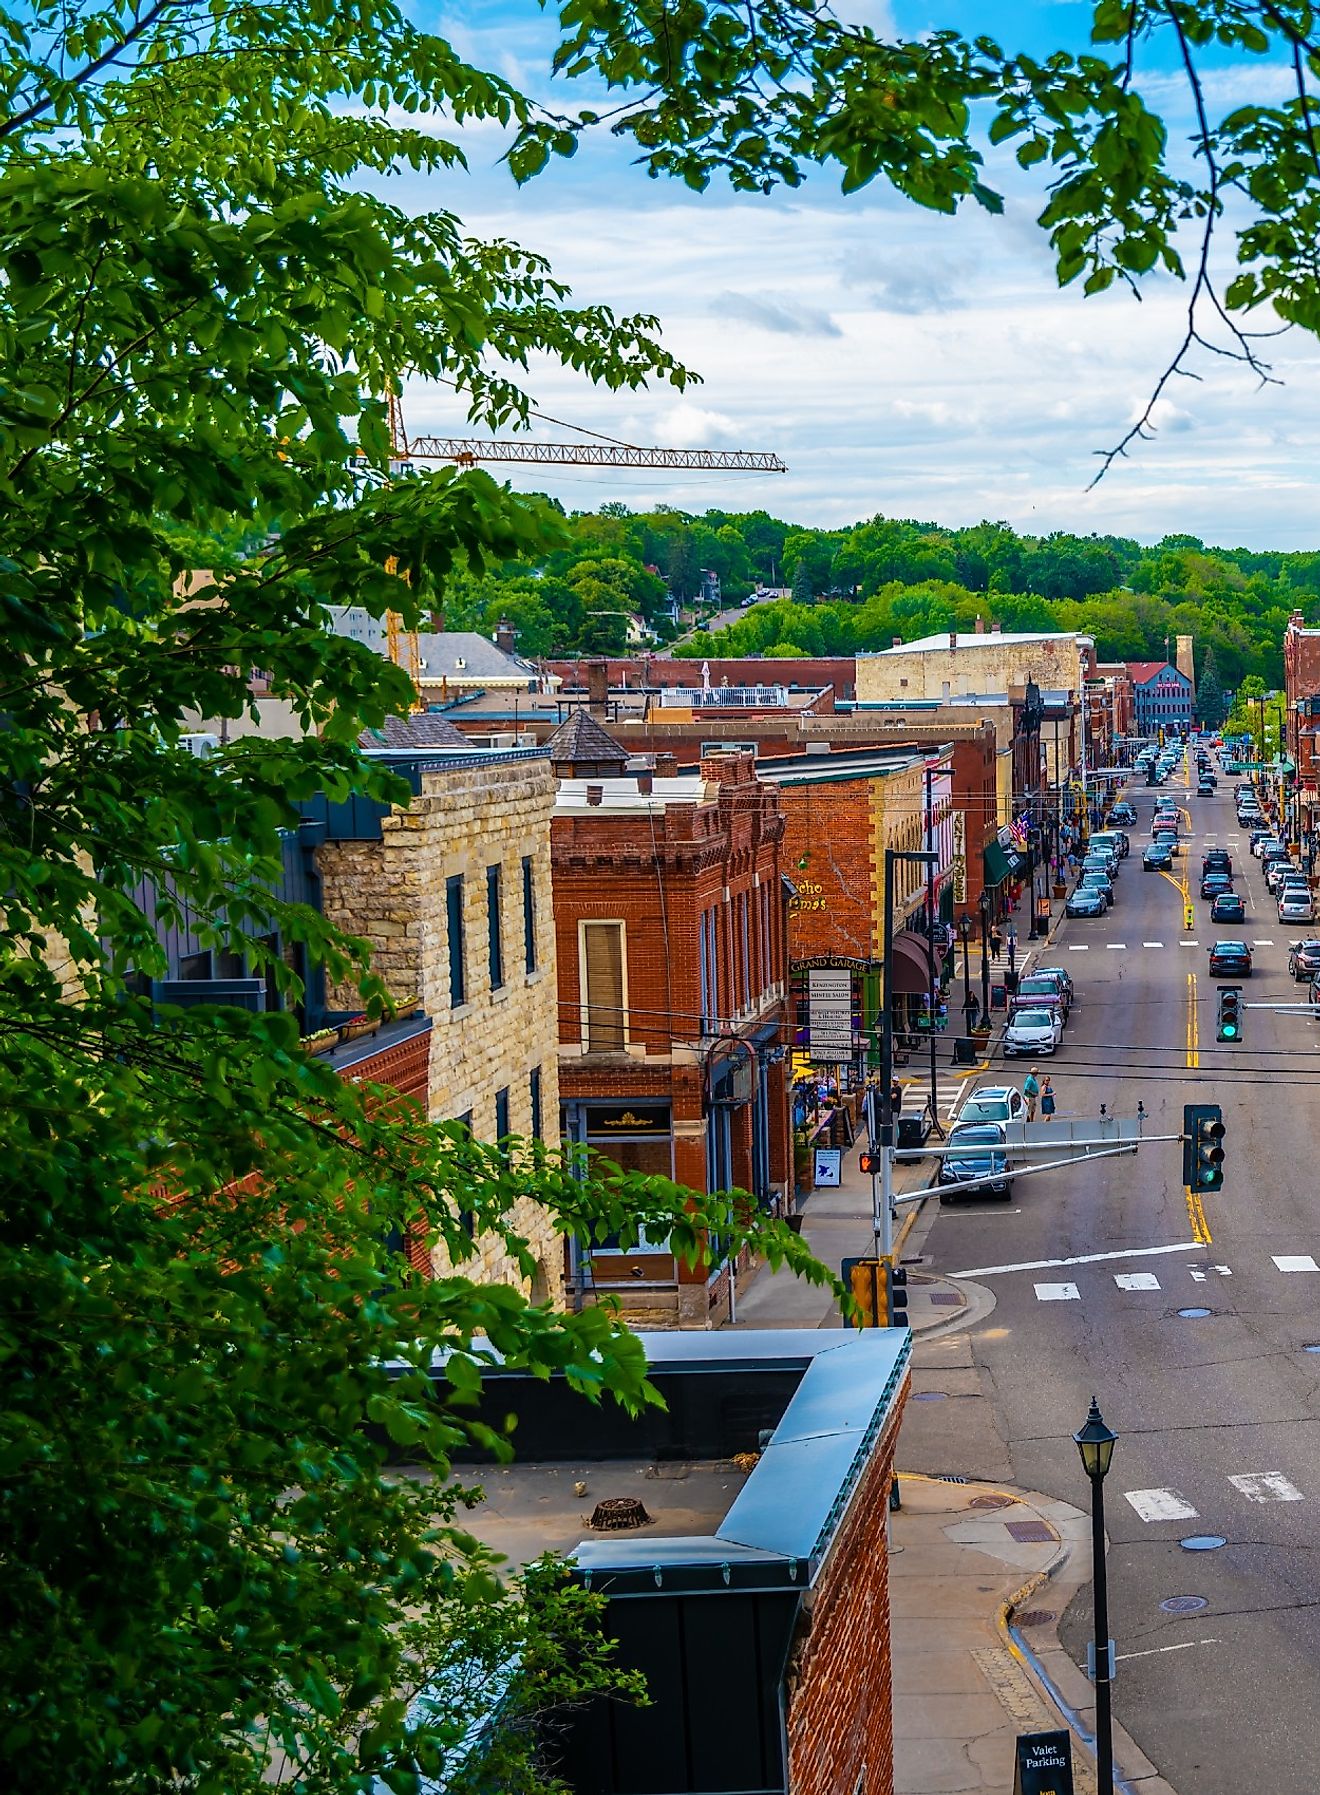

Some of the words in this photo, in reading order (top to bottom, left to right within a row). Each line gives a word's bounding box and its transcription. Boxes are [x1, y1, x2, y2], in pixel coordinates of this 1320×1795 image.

[953, 812, 965, 902] ANTIQUES
[791, 958, 827, 972] GRAND
[829, 957, 868, 972] GARAGE
[1032, 1745, 1058, 1756] Valet
[1025, 1756, 1066, 1769] Parking
